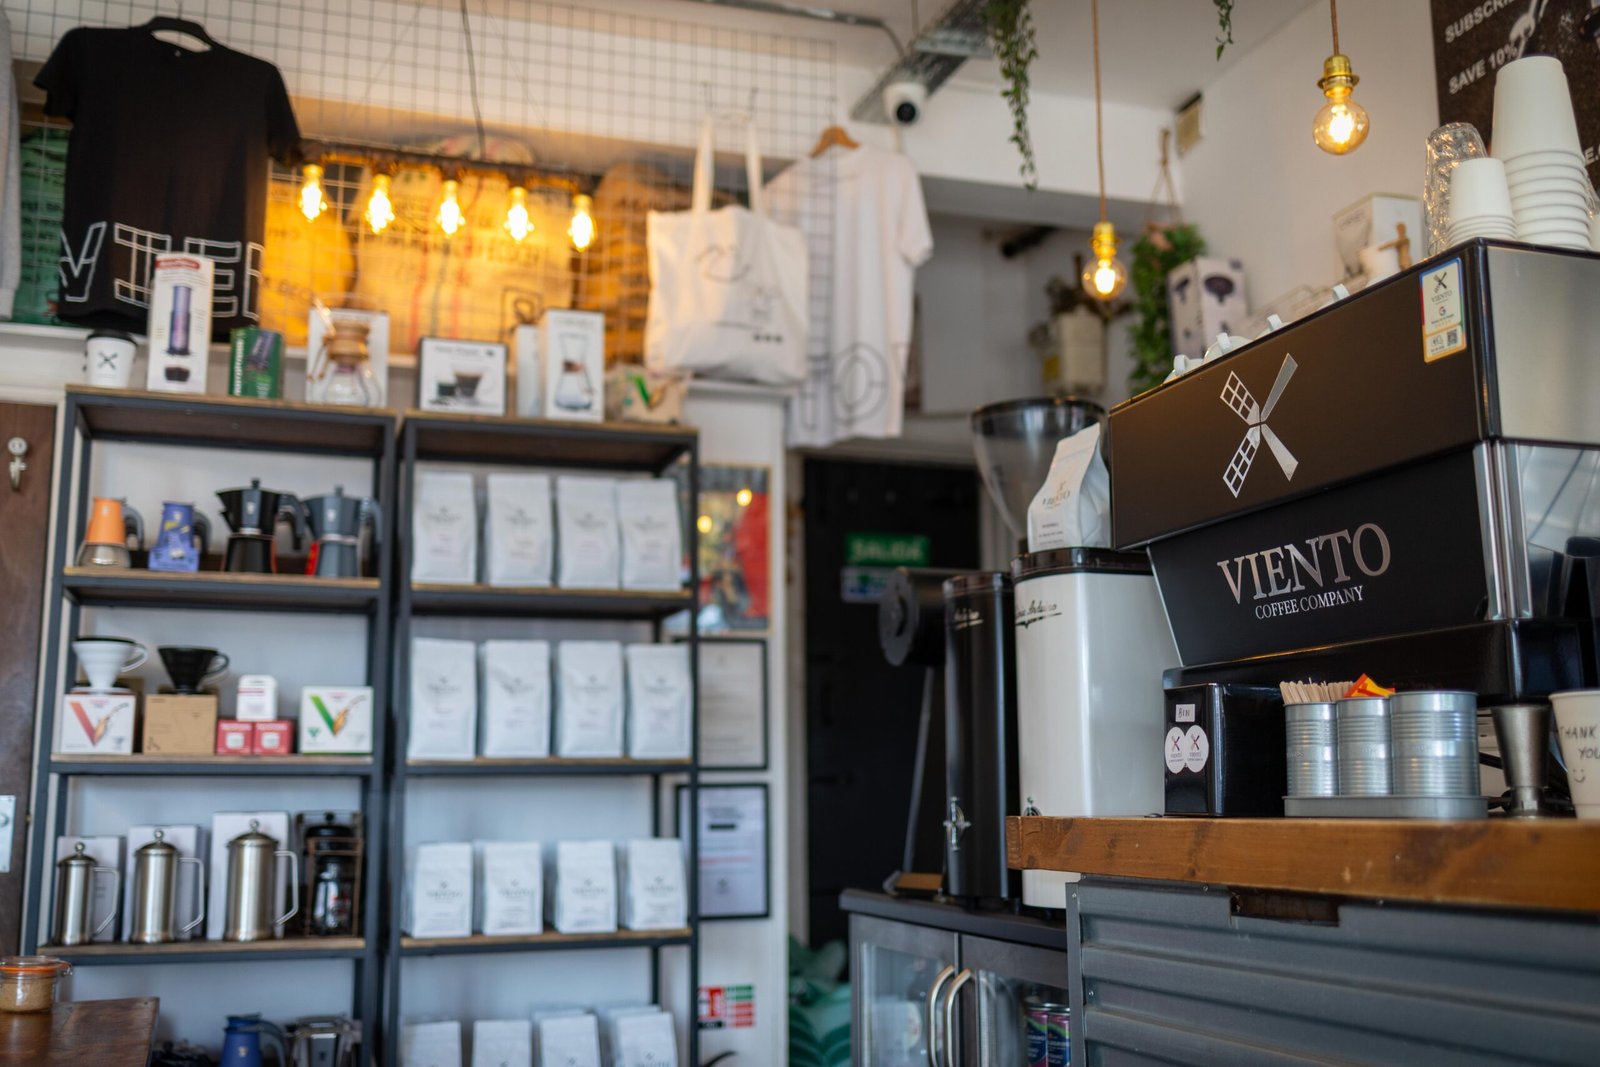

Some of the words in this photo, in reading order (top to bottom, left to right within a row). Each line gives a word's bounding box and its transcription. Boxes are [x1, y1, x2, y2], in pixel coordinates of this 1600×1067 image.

[1445, 0, 1514, 43] SUBSCR
[1448, 58, 1487, 95] SAVE
[1489, 43, 1518, 70] 10%
[1216, 522, 1392, 606] VIENTO
[1254, 598, 1300, 620] COFFEE
[1299, 584, 1364, 613] COMPANY
[1178, 707, 1191, 719] BIN
[1559, 724, 1598, 740] THANK
